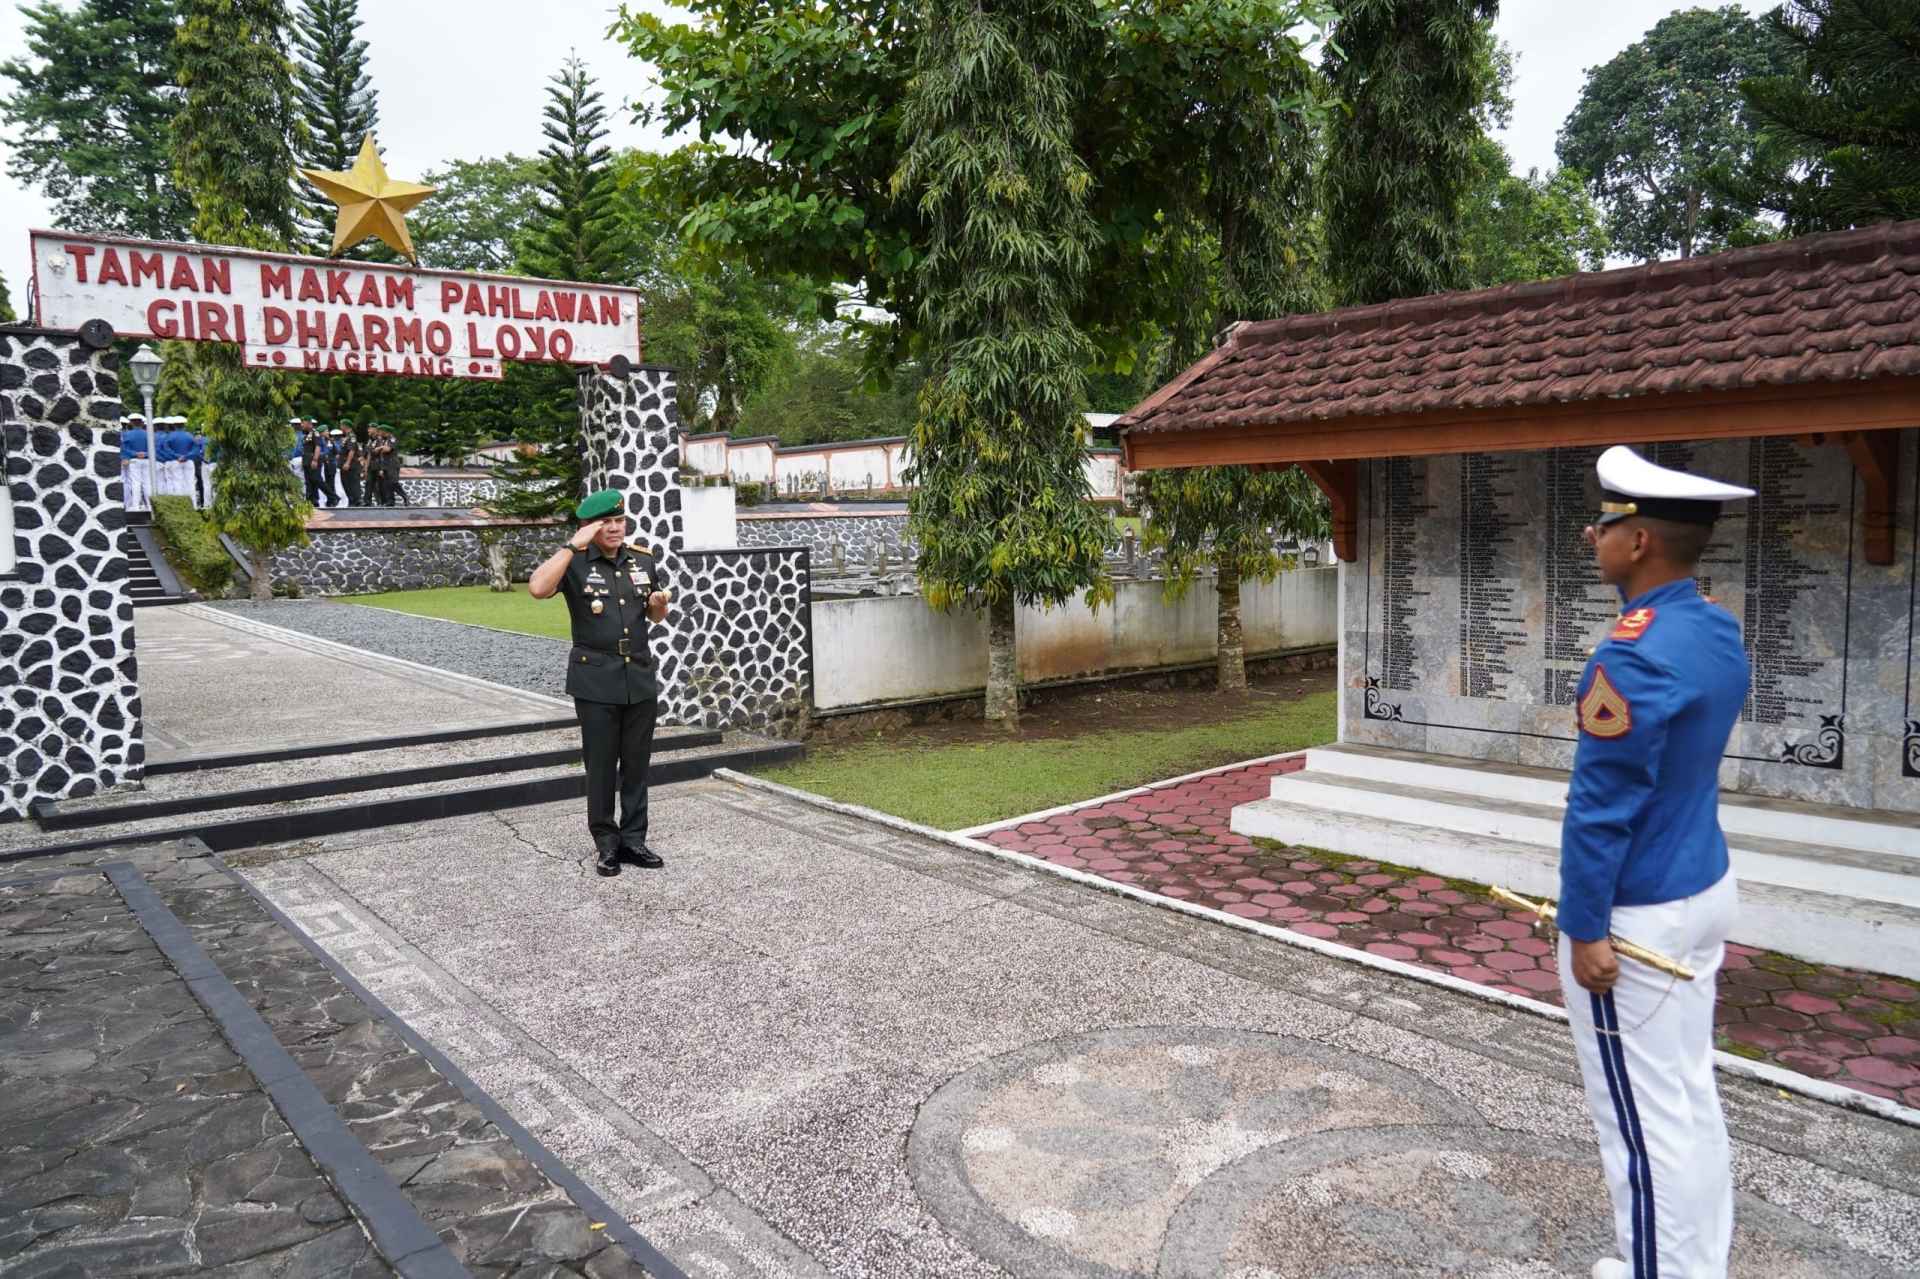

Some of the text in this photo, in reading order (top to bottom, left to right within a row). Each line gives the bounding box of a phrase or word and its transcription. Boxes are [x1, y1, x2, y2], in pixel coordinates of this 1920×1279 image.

[64, 244, 620, 326] TAMAN MAKAM PAHLAWAN
[147, 299, 573, 361] GIRI DHARMO LOYO
[303, 351, 454, 377] MAGELANG
